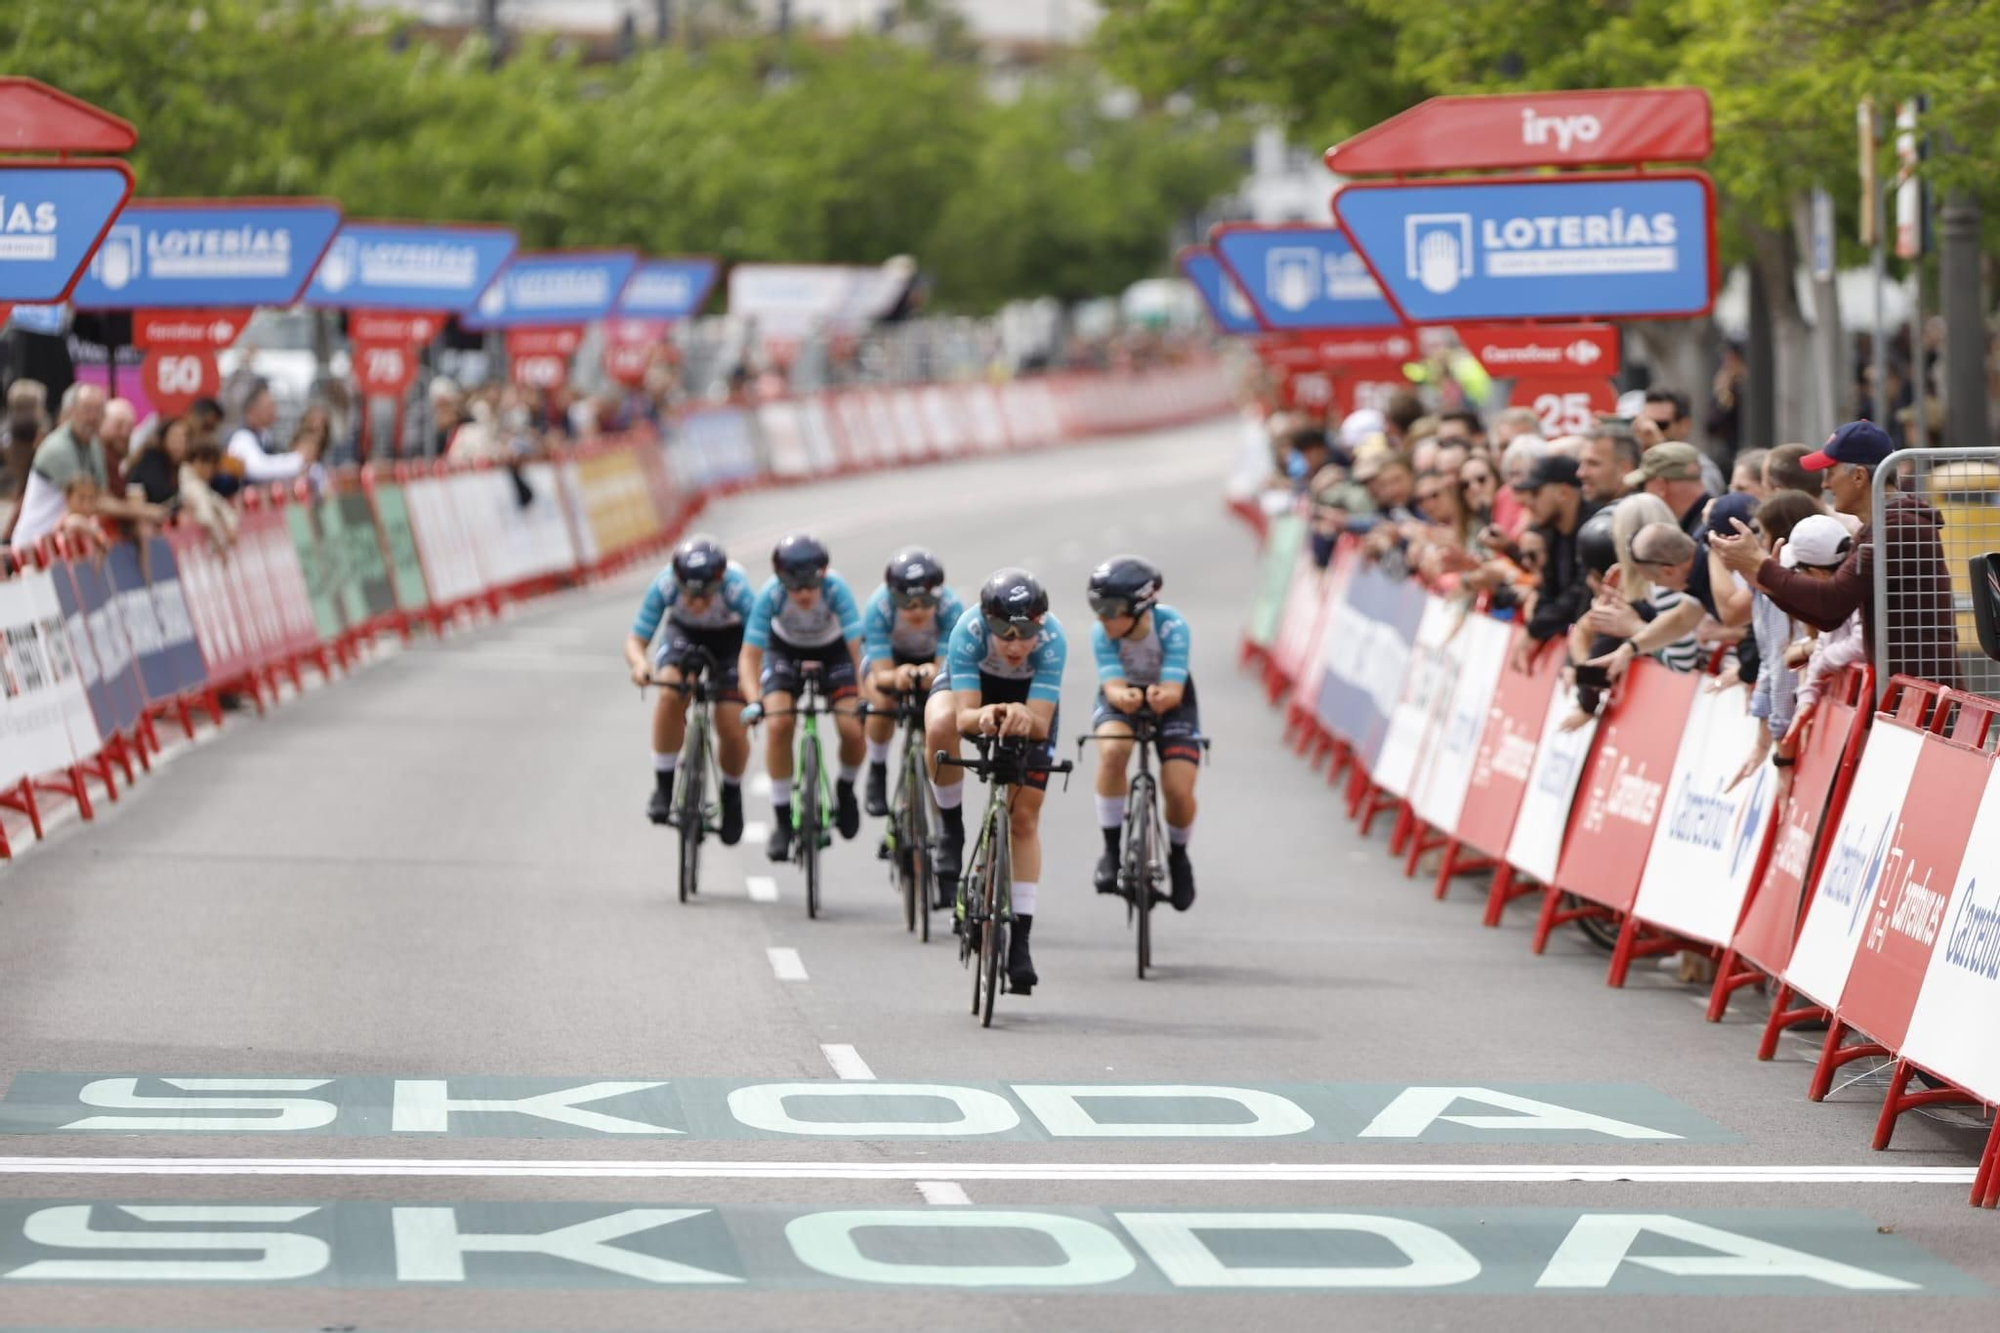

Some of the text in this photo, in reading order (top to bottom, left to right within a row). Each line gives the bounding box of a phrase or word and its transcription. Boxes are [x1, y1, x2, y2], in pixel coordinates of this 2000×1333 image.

[1521, 107, 1600, 153] iryo
[147, 225, 291, 257] LOTERÍAS
[1482, 207, 1677, 250] LOTERÍAS
[157, 355, 203, 394] 50
[1480, 343, 1563, 364] Carrefour
[1533, 392, 1592, 437] 25
[1891, 859, 1946, 946] Carrefour.es
[57, 1077, 1688, 1139] SKODA
[3, 1204, 1922, 1291] SKODA
